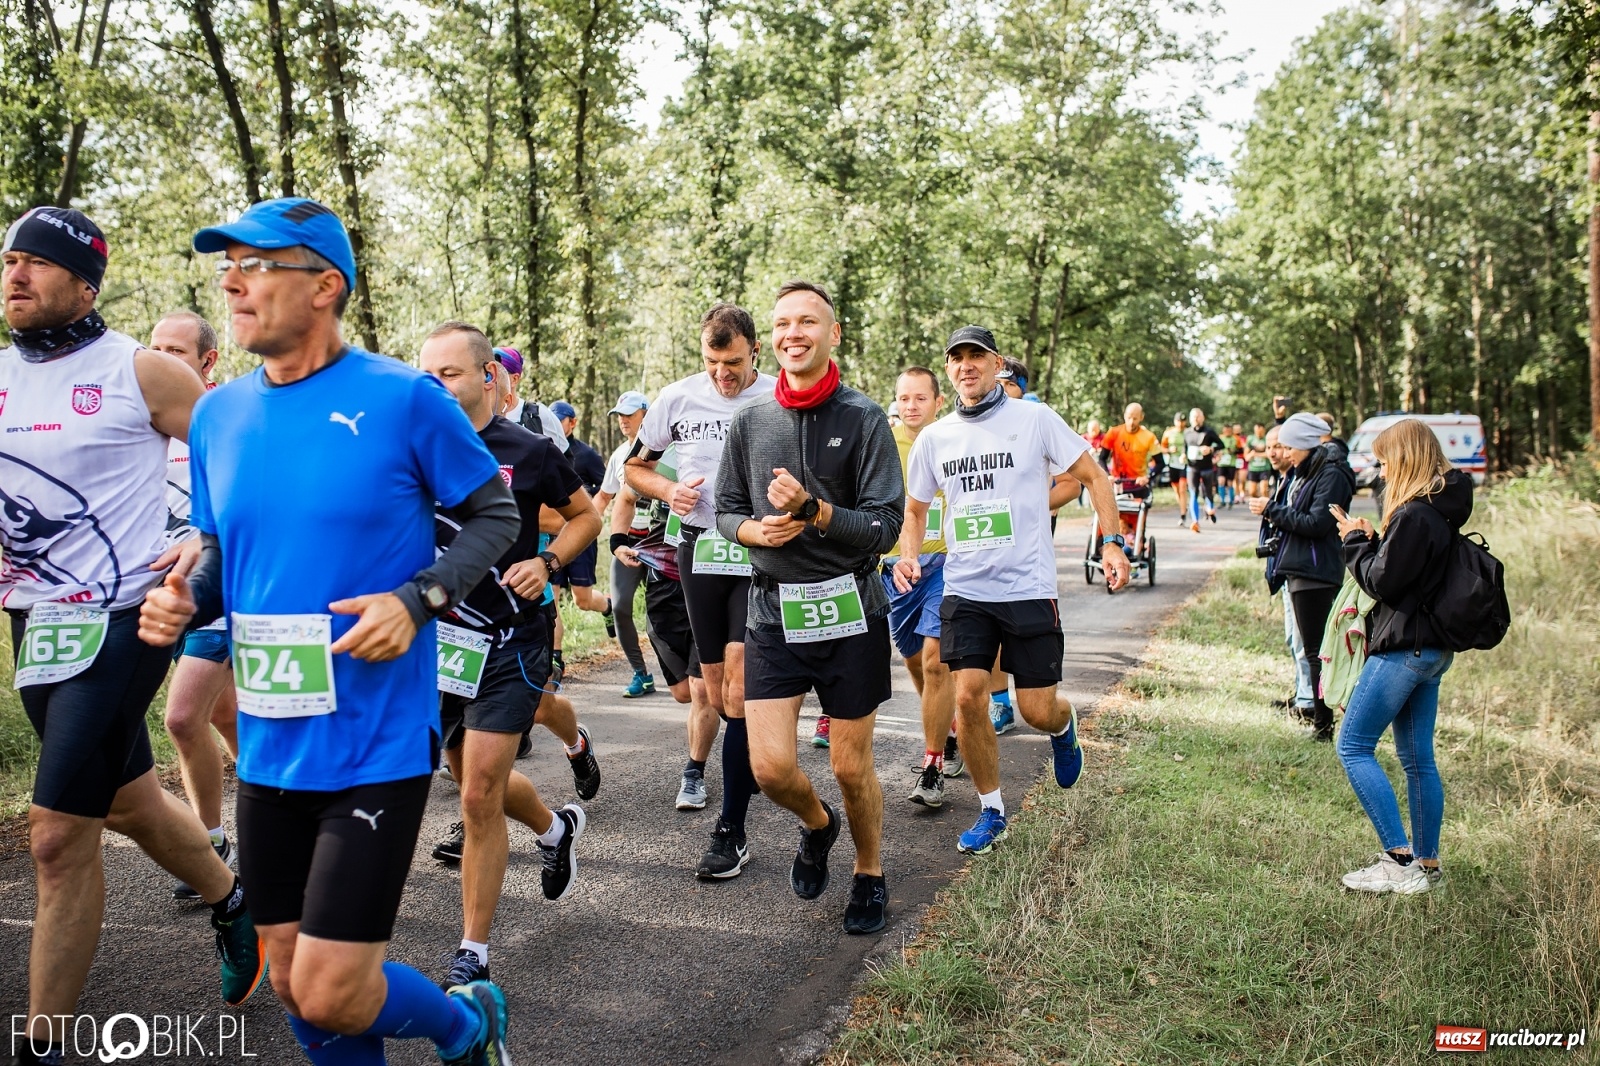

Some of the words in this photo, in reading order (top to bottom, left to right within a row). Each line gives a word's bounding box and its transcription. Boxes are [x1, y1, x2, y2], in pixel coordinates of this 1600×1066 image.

[942, 456, 978, 479] NOWA
[980, 452, 1014, 471] HUTA
[960, 473, 994, 493] TEAM
[965, 516, 995, 539] 32
[712, 541, 743, 563] 56
[800, 600, 840, 627] 39
[24, 628, 82, 665] 165
[238, 647, 305, 691] 124
